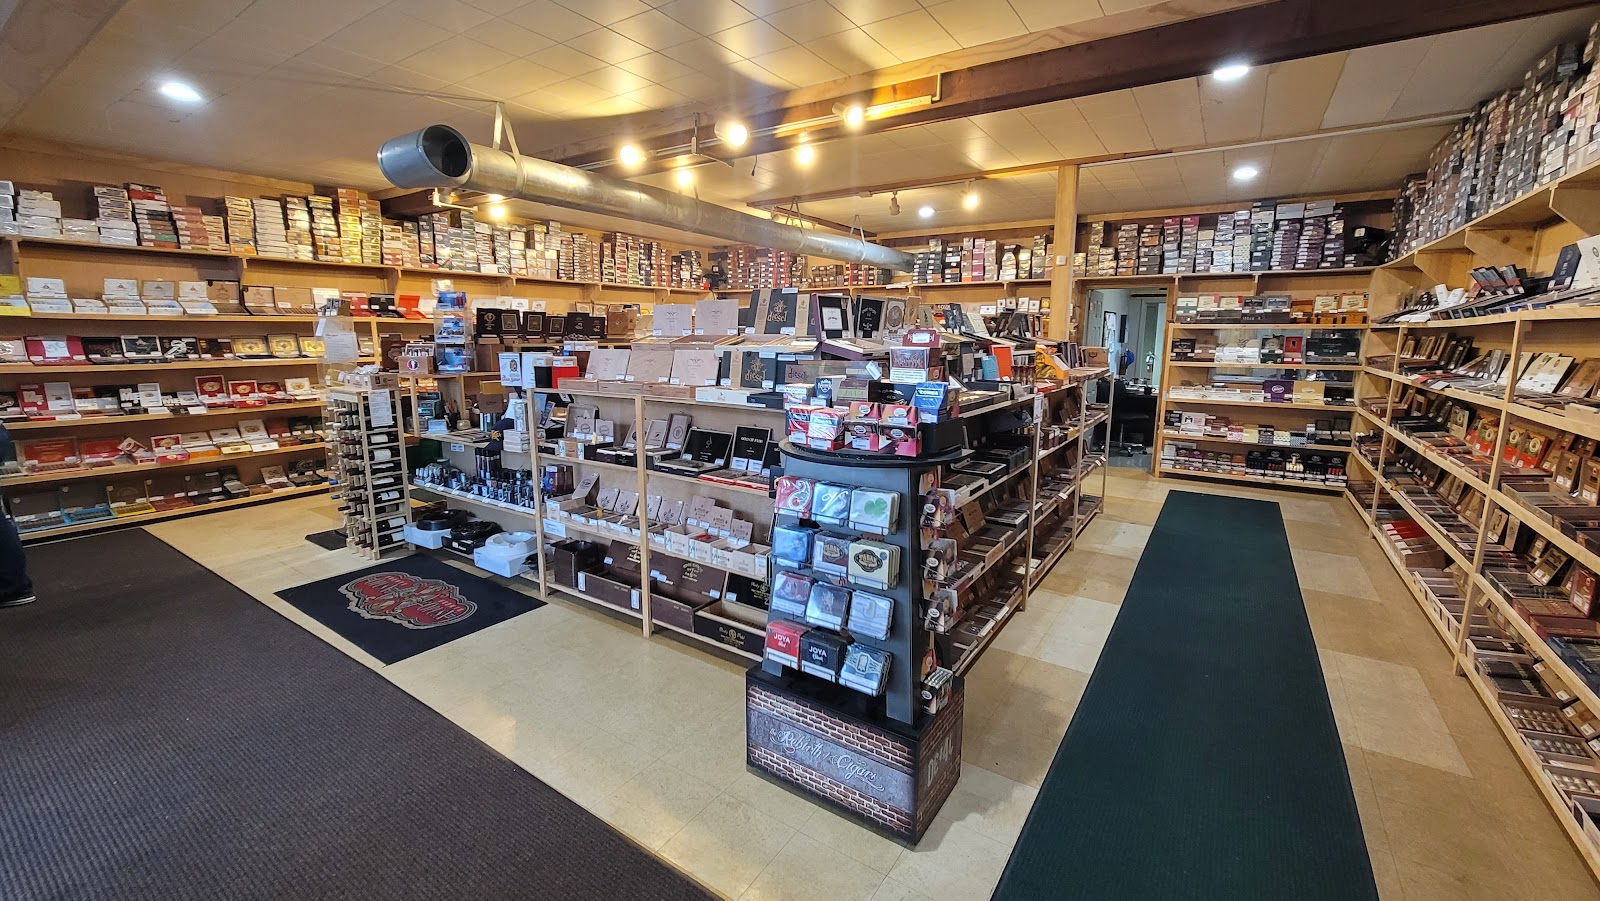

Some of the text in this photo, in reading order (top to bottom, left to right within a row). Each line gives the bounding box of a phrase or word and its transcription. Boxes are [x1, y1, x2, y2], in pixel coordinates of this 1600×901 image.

[767, 310, 788, 322] diesel
[745, 369, 767, 382] diesel
[774, 633, 791, 644] JOYA
[809, 645, 827, 657] JOYA
[780, 730, 824, 758] Rebirth
[832, 754, 879, 784] Cigars
